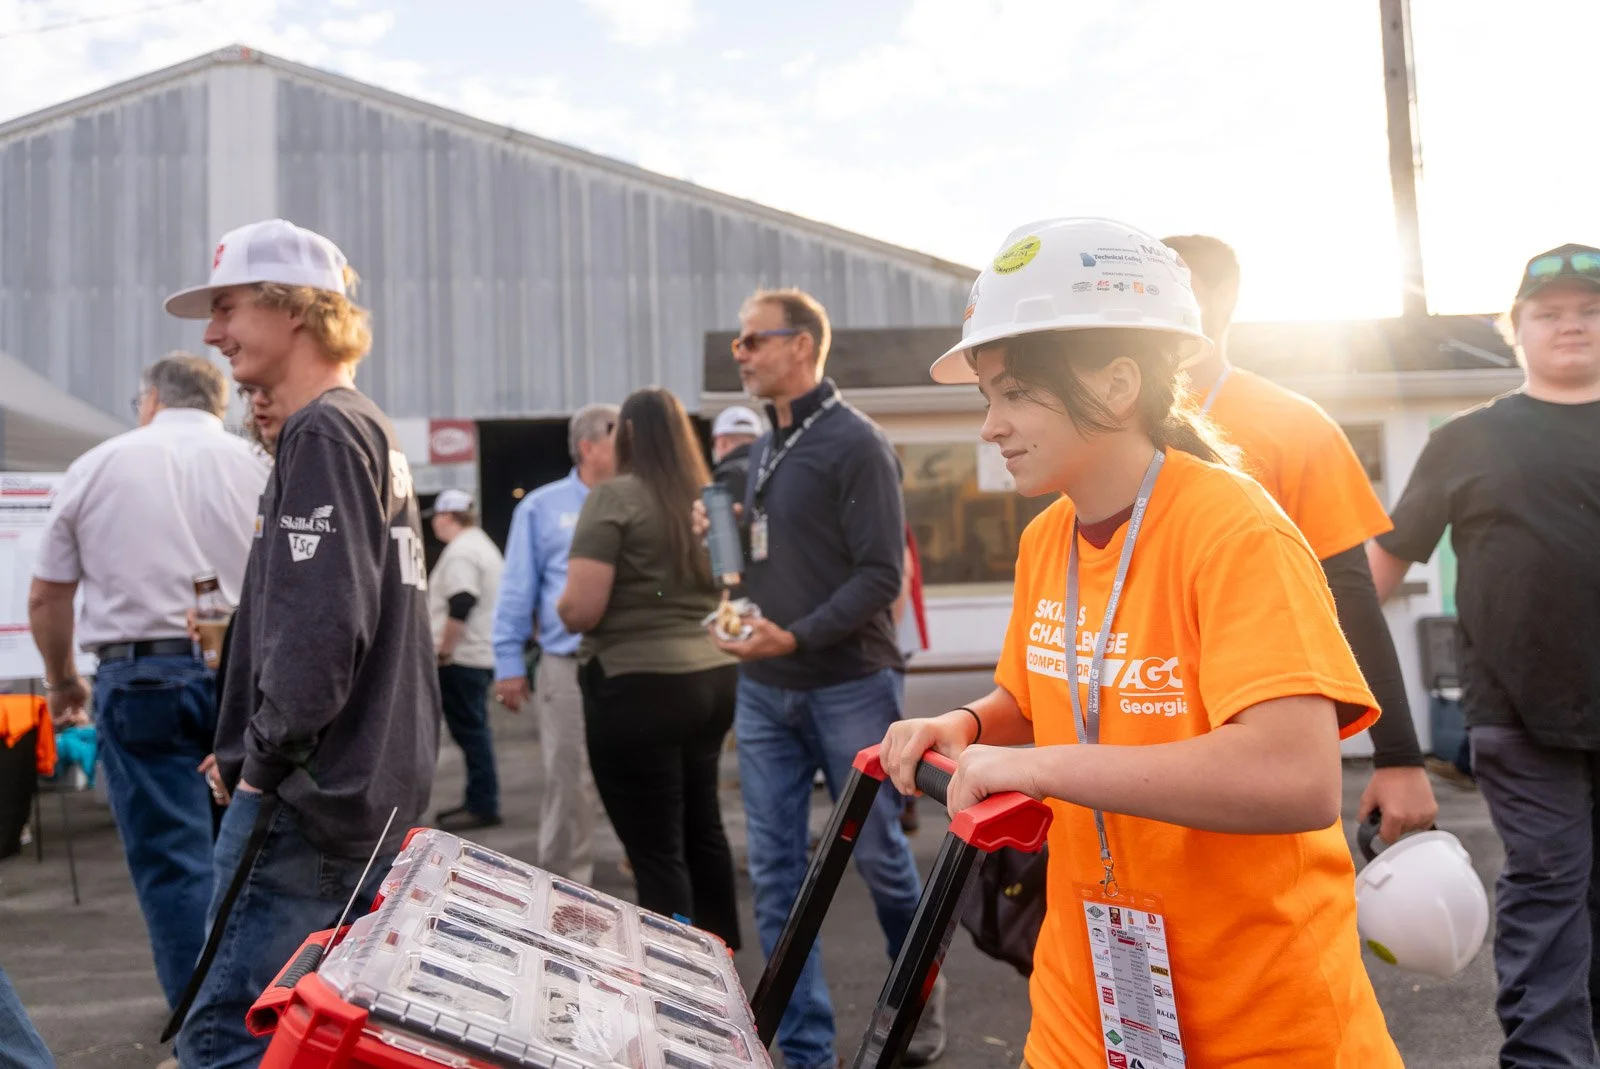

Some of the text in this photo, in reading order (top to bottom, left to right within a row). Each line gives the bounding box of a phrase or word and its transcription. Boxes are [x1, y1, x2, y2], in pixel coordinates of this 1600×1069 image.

[293, 536, 314, 556] TSC
[1035, 599, 1087, 626] SKIS
[1028, 652, 1090, 678] COMPETOR
[1118, 656, 1184, 691] AGC
[1156, 1008, 1176, 1020] RA-LIN
